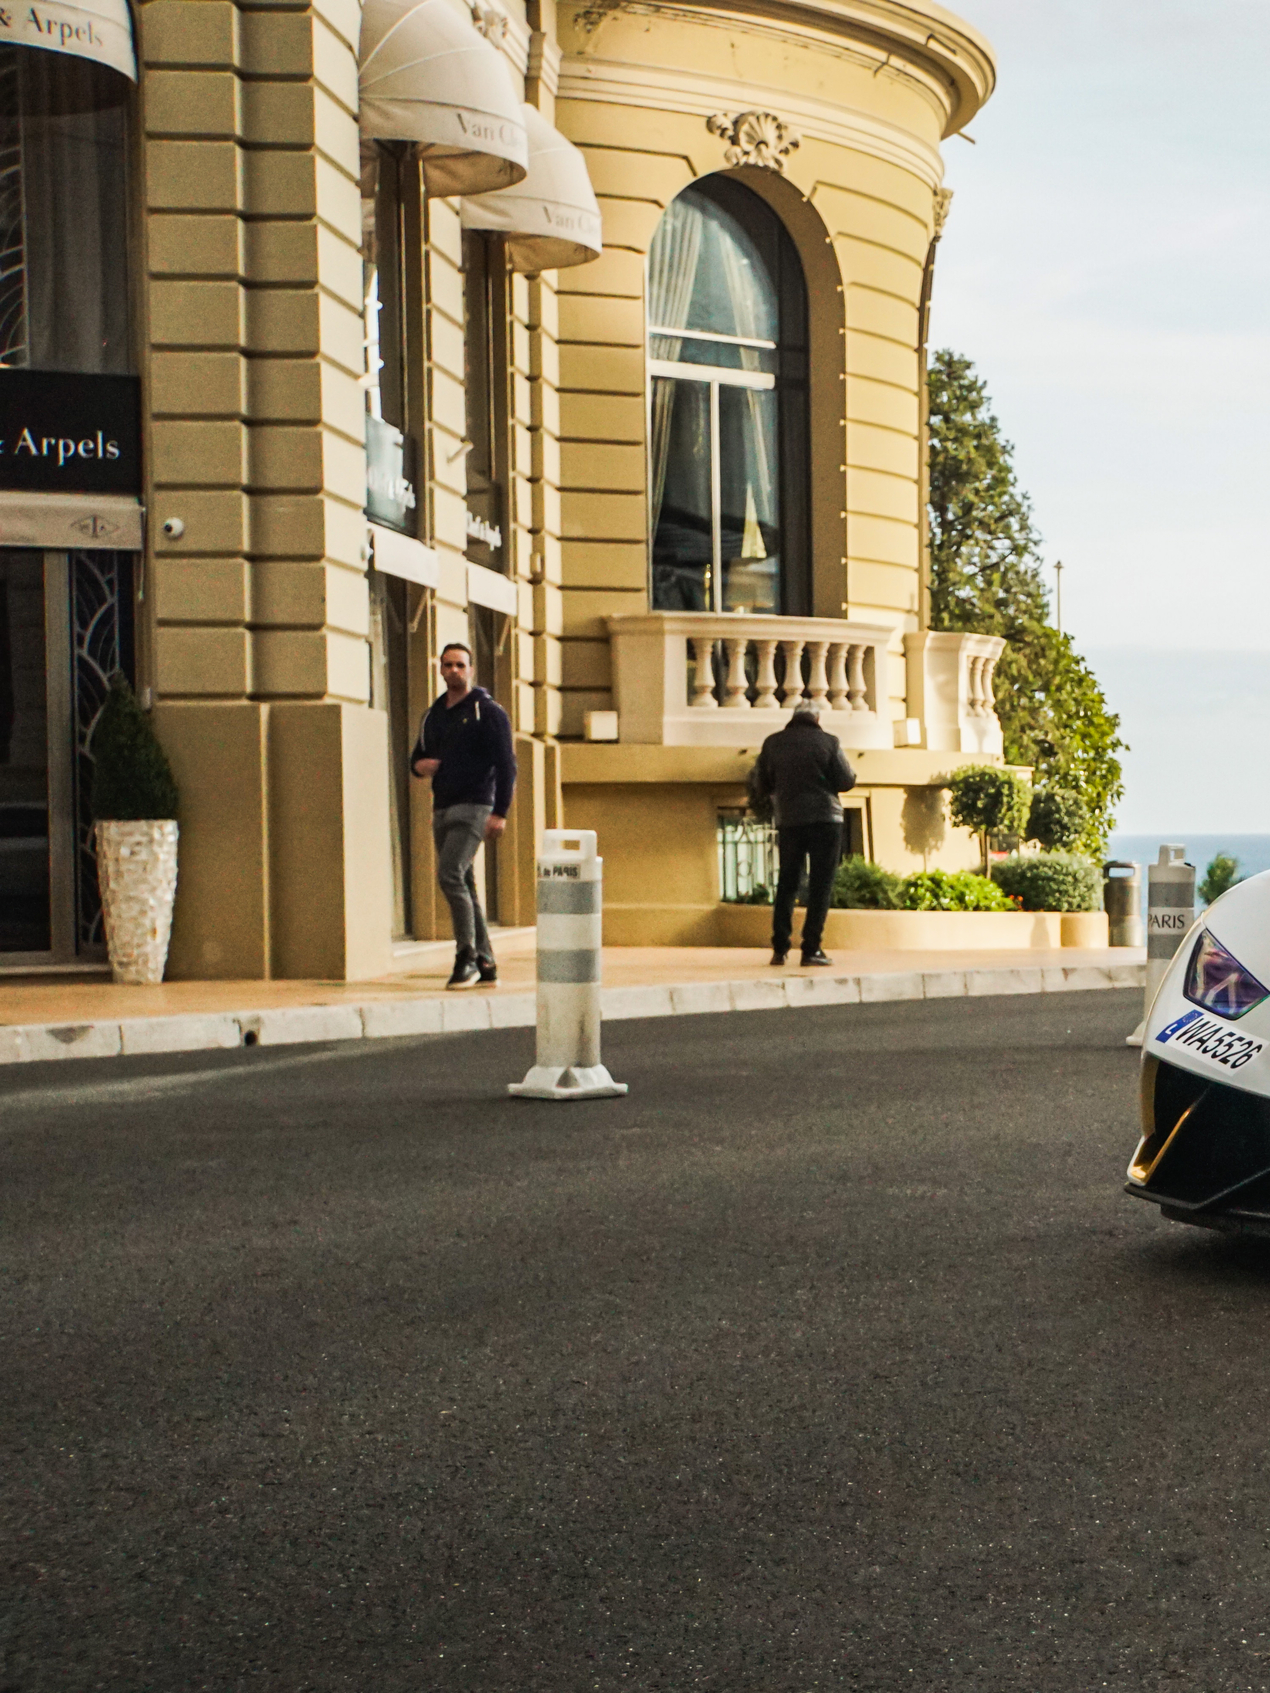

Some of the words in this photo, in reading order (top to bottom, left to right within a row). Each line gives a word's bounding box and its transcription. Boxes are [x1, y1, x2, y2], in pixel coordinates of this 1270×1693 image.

[23, 7, 104, 46] Arpels
[456, 112, 495, 142] Van
[543, 204, 576, 229] Van
[14, 427, 121, 467] Arpels
[552, 865, 579, 877] PARIS
[1174, 1017, 1264, 1070] WA5526
